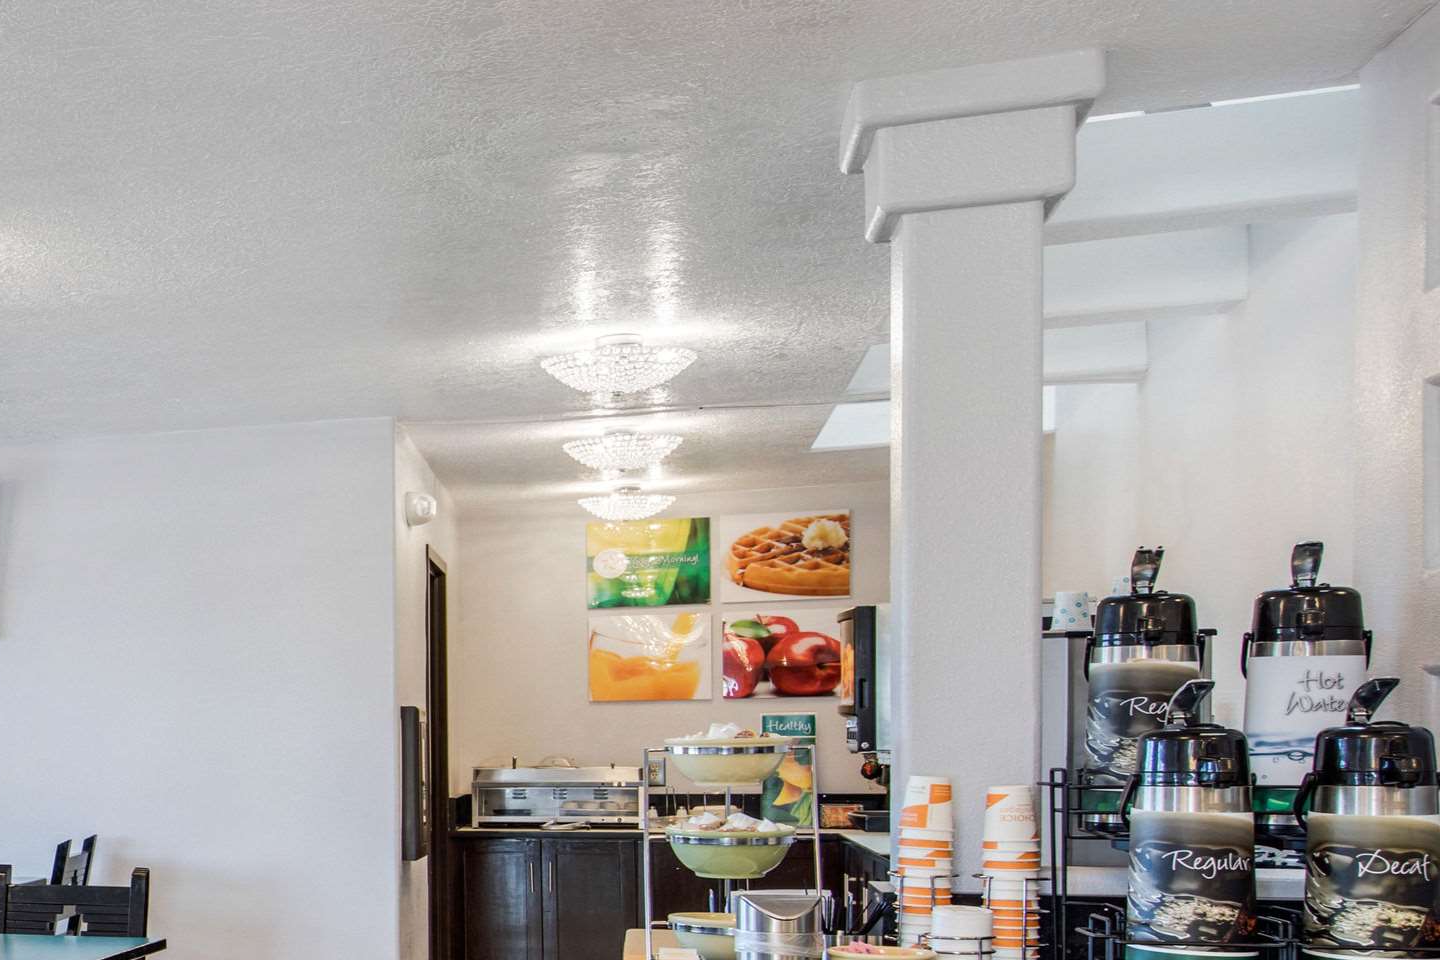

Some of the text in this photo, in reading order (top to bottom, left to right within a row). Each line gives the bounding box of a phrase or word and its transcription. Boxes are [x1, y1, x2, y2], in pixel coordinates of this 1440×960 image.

[1297, 669, 1345, 692] Hot
[1285, 691, 1349, 716] Wate
[767, 719, 812, 735] Healthy
[1161, 849, 1250, 879] Regular
[1355, 848, 1430, 882] Decaf
